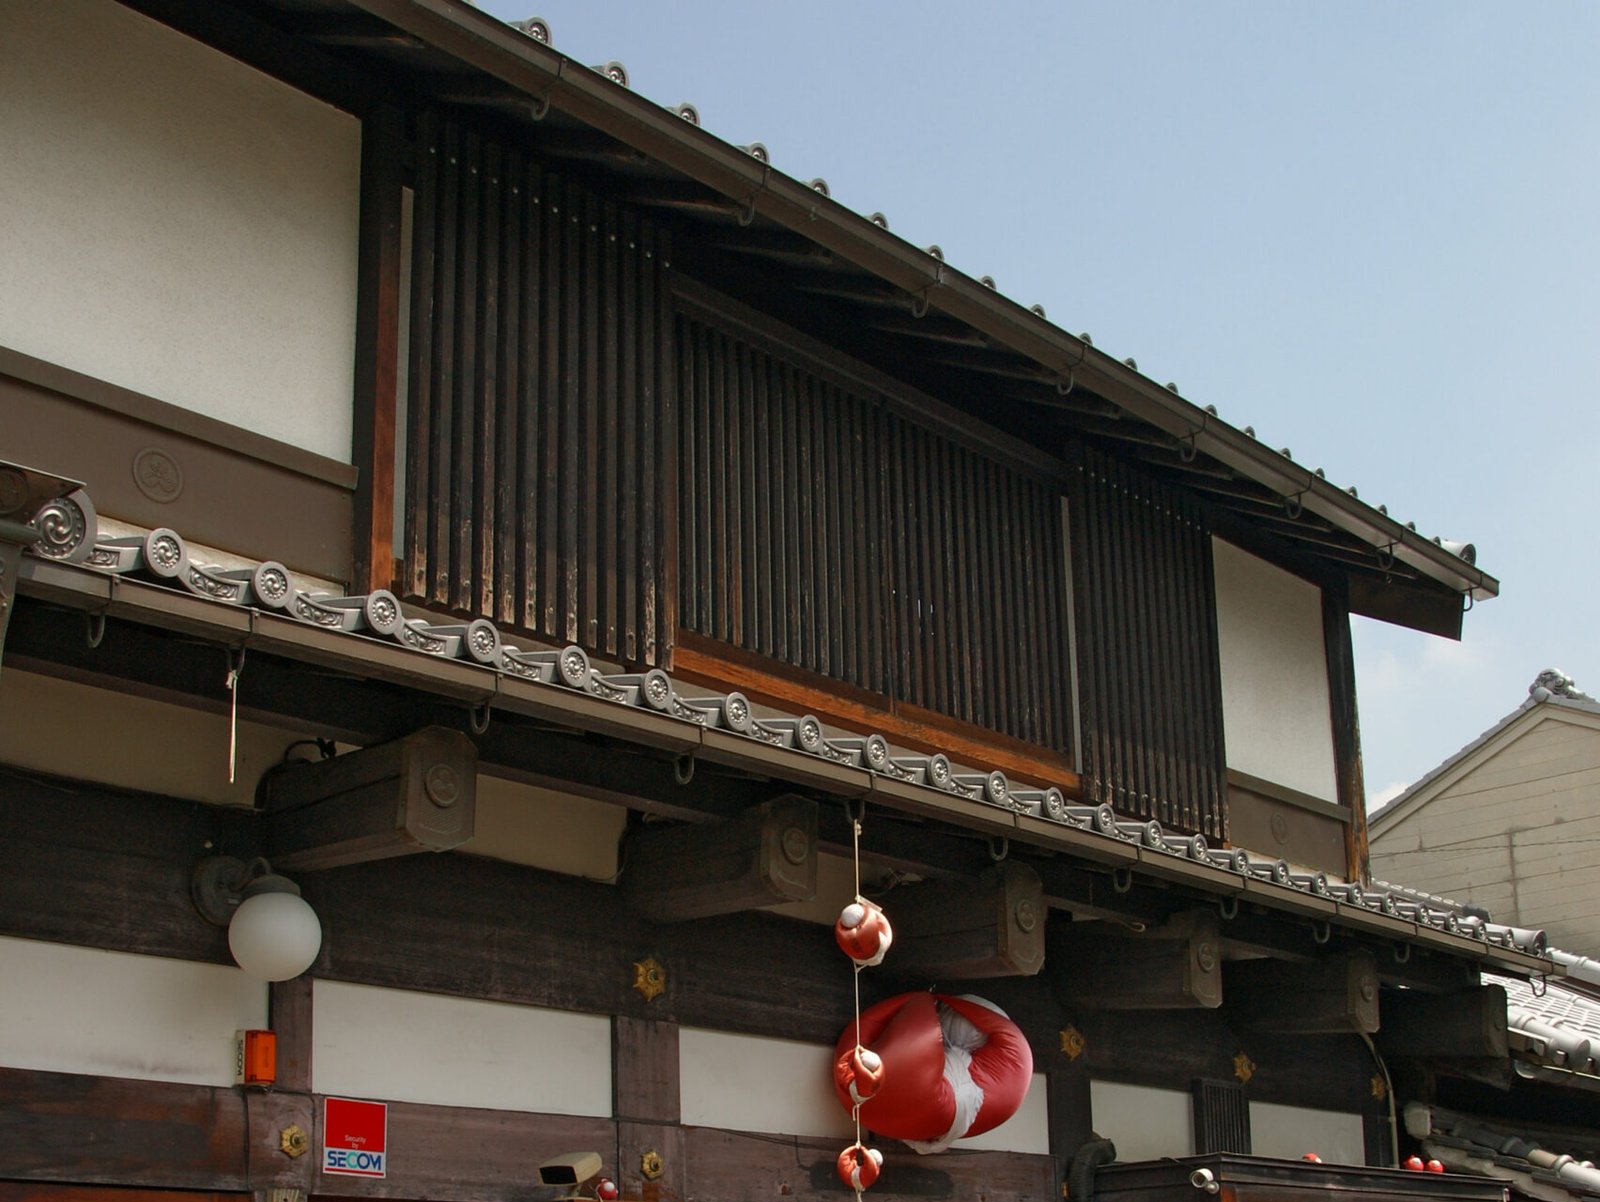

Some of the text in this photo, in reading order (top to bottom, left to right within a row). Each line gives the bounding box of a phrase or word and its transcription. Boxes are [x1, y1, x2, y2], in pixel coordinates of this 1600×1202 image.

[236, 1039, 244, 1077] SECOM
[344, 1134, 367, 1145] Security
[351, 1141, 359, 1150] by
[327, 1150, 382, 1170] SECOM
